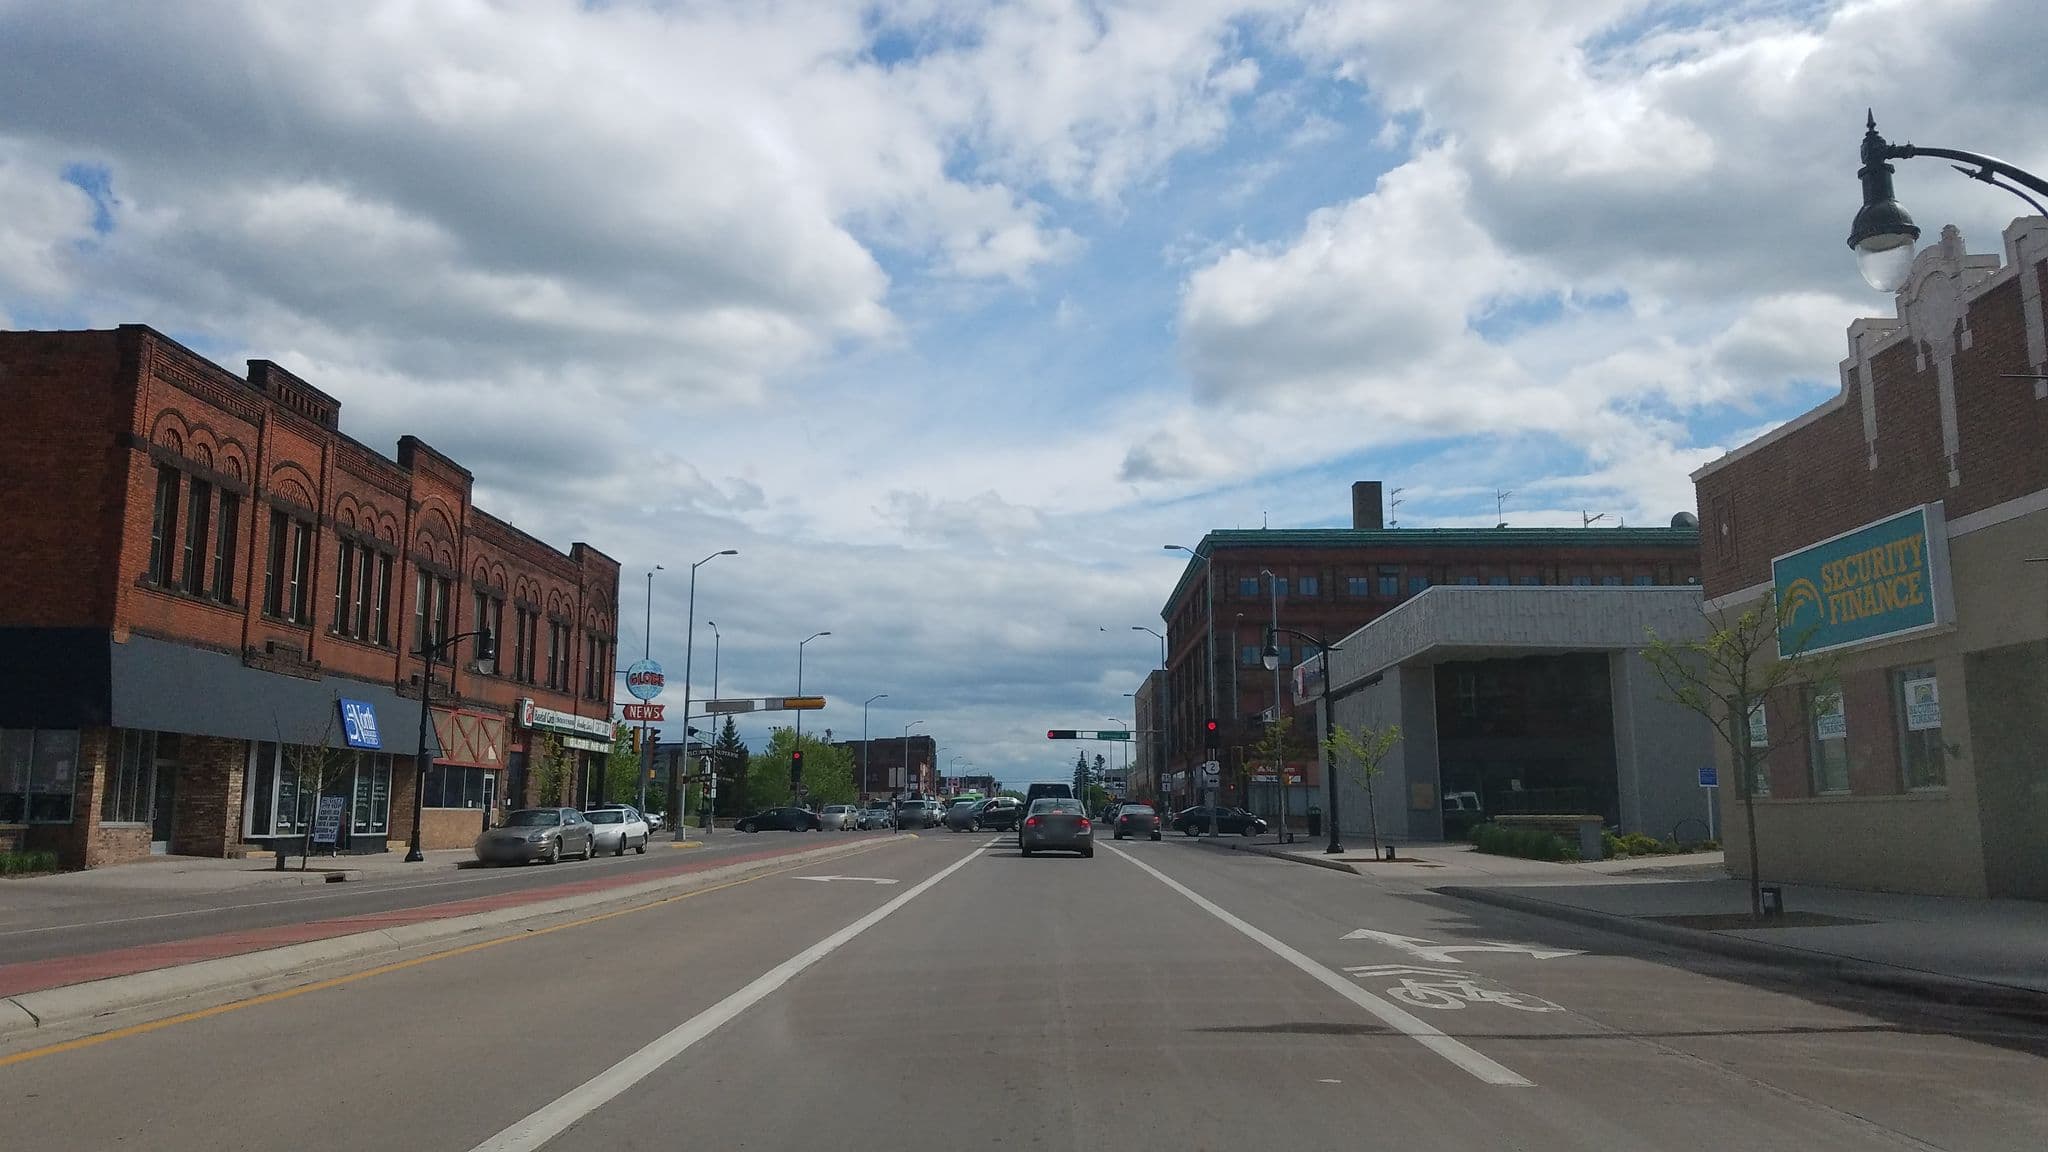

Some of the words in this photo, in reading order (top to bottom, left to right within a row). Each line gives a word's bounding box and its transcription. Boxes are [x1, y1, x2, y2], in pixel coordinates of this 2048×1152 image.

[1822, 534, 1921, 592] SECURITY
[1829, 571, 1924, 625] FINANCE
[630, 671, 664, 687] GLOBE
[630, 705, 660, 719] NEWS
[569, 738, 590, 749] GLOBE
[591, 741, 609, 752] NEWS
[1210, 763, 1216, 771] 2
